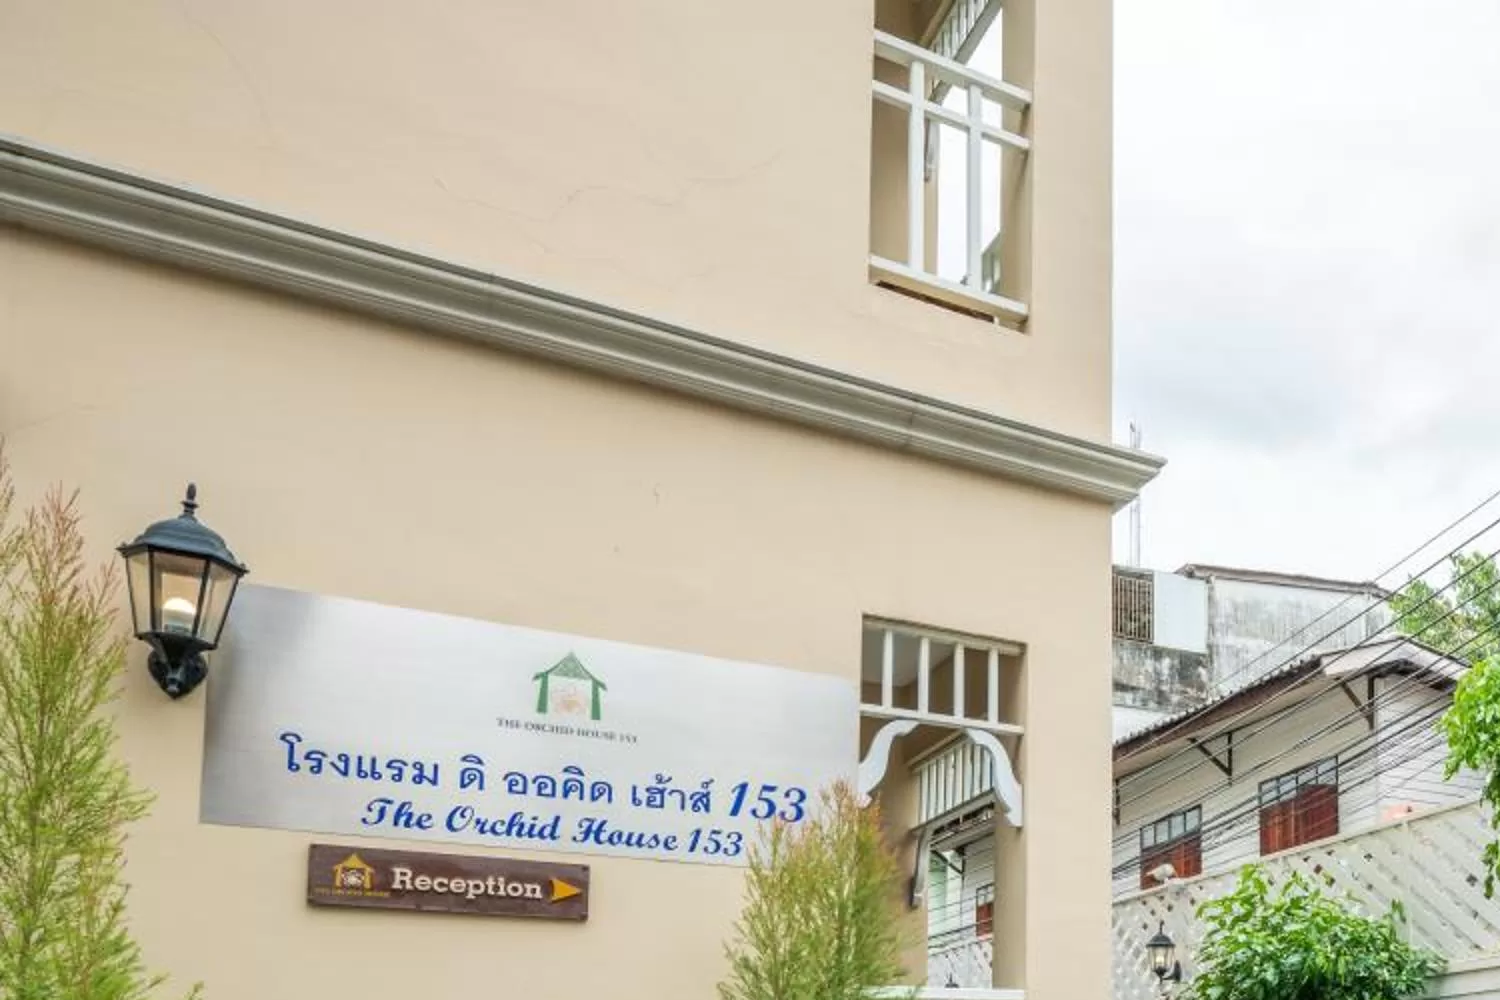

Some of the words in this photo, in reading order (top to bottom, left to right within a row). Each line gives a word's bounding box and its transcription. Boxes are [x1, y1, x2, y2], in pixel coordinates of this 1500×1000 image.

[279, 732, 440, 787] โรงแรม
[458, 754, 486, 792] ดิ
[502, 765, 613, 804] ออคิด
[631, 773, 714, 814] เฮ้าส์
[728, 781, 807, 823] 153
[361, 797, 434, 830] The
[445, 804, 561, 842] Orchid
[572, 816, 679, 851] House
[687, 827, 744, 857] 153
[390, 867, 543, 900] Reception
